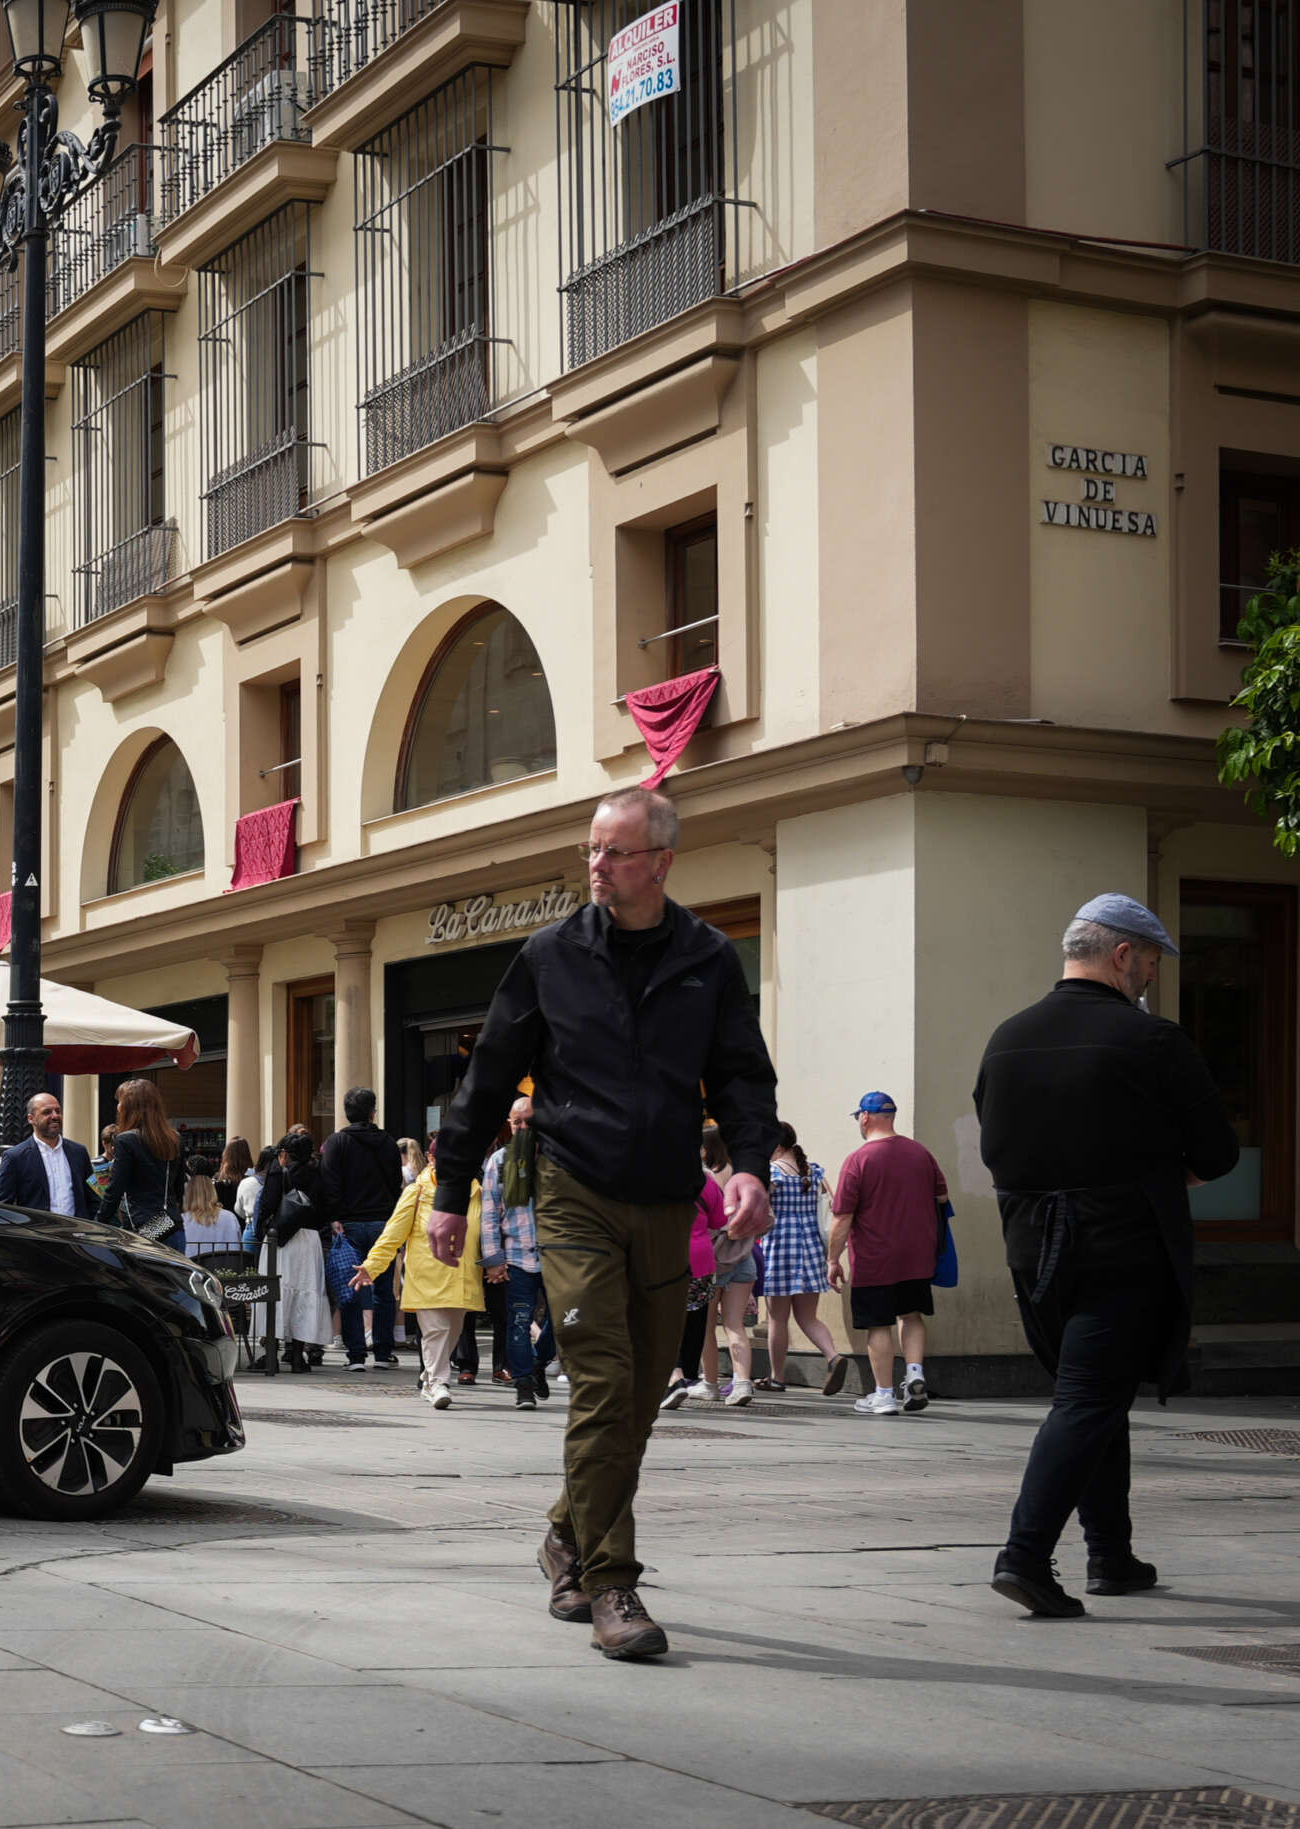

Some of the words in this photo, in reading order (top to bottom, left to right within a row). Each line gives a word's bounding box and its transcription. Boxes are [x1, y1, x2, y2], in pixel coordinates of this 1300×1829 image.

[610, 7, 675, 62] ALQUILER
[627, 41, 665, 69] NARCISO
[656, 52, 676, 68] S.L.
[1051, 445, 1148, 478] GARCIA
[1084, 479, 1115, 502] DE
[1043, 501, 1156, 536] VINUESA
[426, 903, 464, 944] La
[464, 884, 578, 937] Canasta
[224, 1285, 269, 1301] Canasta
